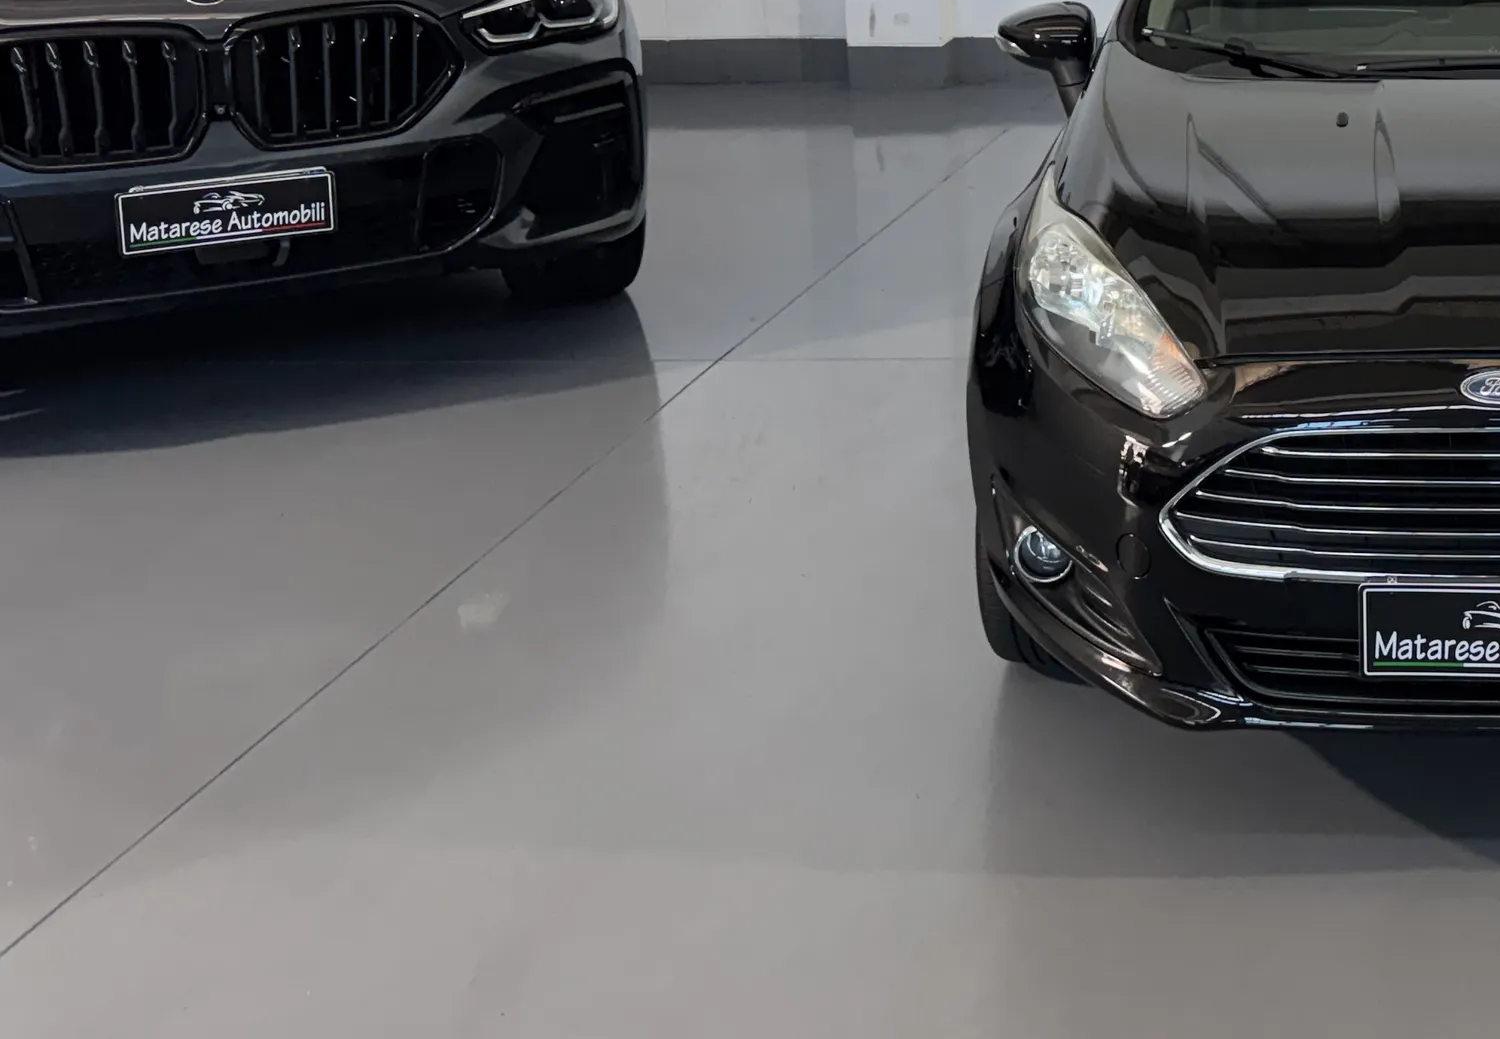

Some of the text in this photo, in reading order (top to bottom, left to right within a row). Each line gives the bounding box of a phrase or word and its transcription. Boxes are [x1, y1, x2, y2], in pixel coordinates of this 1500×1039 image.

[130, 202, 325, 243] Matarese Automobili
[1374, 630, 1500, 661] Matarese
